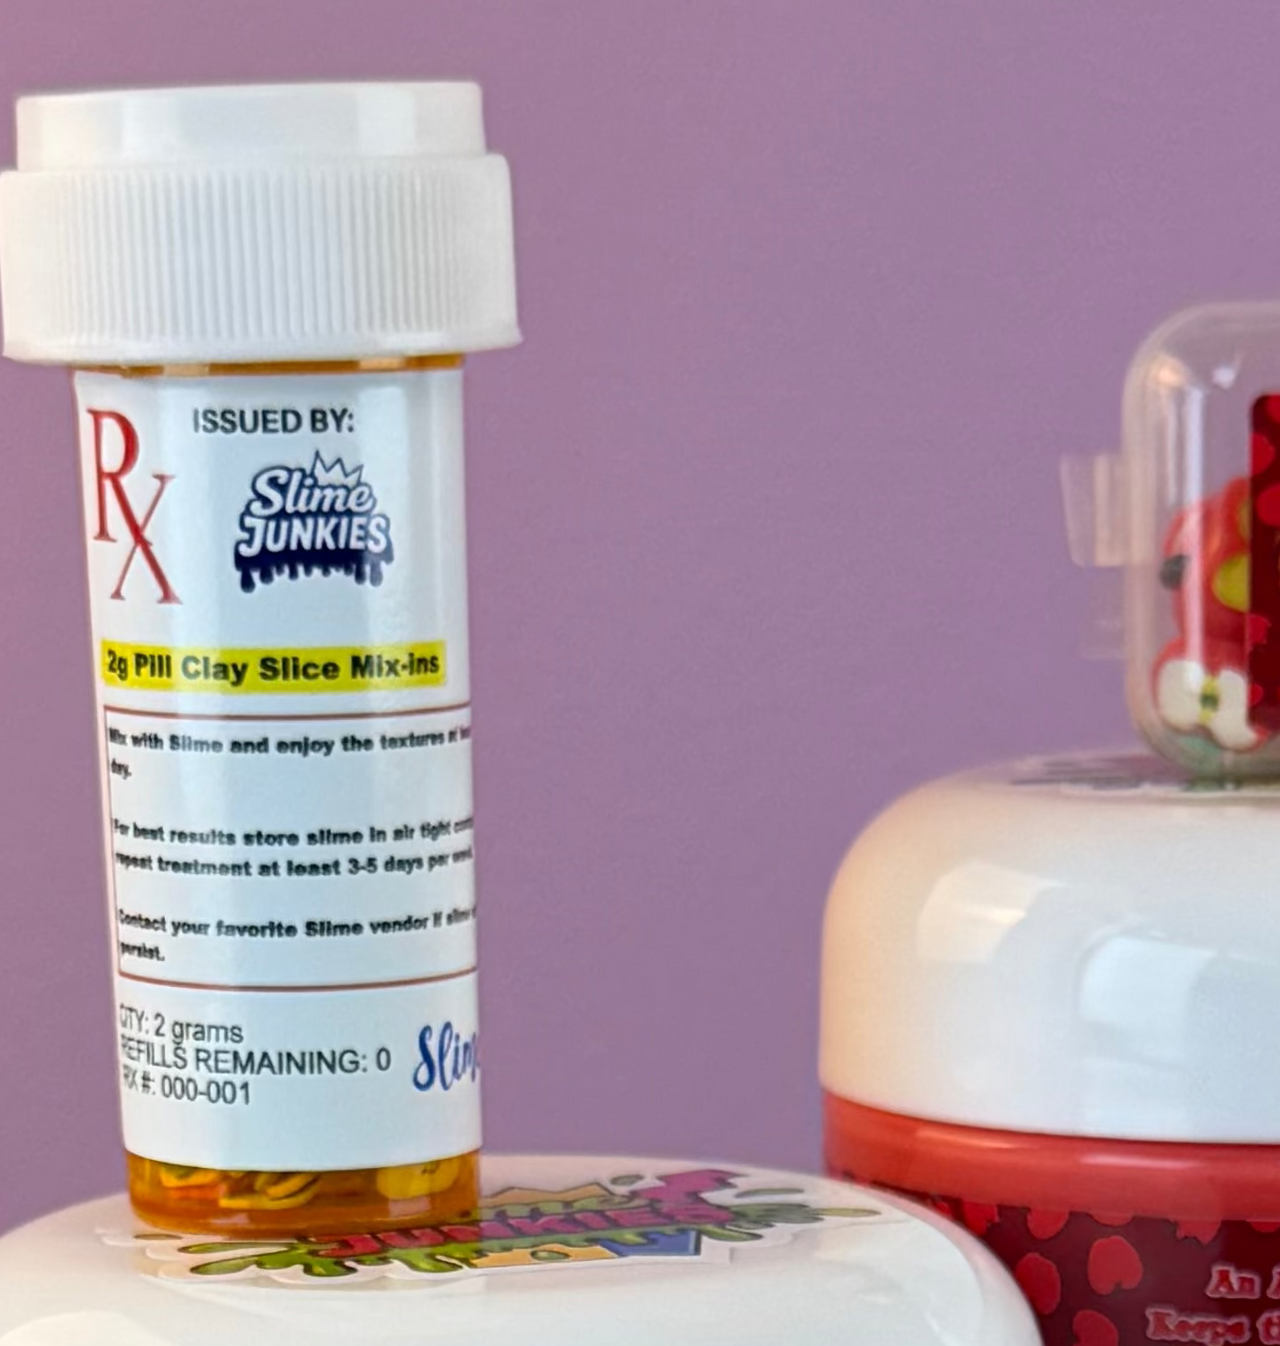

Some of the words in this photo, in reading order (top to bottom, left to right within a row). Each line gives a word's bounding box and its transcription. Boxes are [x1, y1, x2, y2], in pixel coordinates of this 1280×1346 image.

[194, 408, 302, 434] ISSUED
[311, 408, 354, 433] BY:
[249, 466, 377, 518] Slime
[237, 513, 389, 558] JUNKIES
[108, 649, 128, 681] 2g
[134, 653, 171, 678] Pill
[181, 655, 249, 687] Clay
[260, 656, 340, 681] Slice
[351, 652, 439, 679] Mix-ins
[131, 732, 164, 751] with
[169, 734, 224, 752] Slime
[231, 737, 269, 753] and
[276, 736, 335, 757] enjoy
[341, 734, 375, 752] the
[380, 731, 444, 750] textures
[133, 823, 165, 842] best
[170, 829, 236, 845] results
[243, 830, 299, 846] store
[307, 828, 363, 845] slime
[370, 826, 387, 842] in
[393, 823, 415, 841] air
[420, 819, 451, 842] tight
[157, 856, 252, 877] treatment
[258, 861, 280, 877] at
[287, 859, 341, 877] least
[348, 857, 378, 875] 3-5
[384, 854, 424, 875] days
[428, 853, 449, 872] per
[119, 909, 166, 933] Contact
[171, 918, 210, 937] your
[217, 919, 298, 938] favorite
[305, 920, 364, 937] Slime
[370, 912, 429, 935] vendor
[154, 1012, 166, 1037] 2
[172, 1020, 244, 1045] grams
[195, 1046, 367, 1076] REMAINING:
[376, 1047, 392, 1072] 0
[161, 1074, 250, 1106] 000-001
[1206, 1262, 1261, 1299] An
